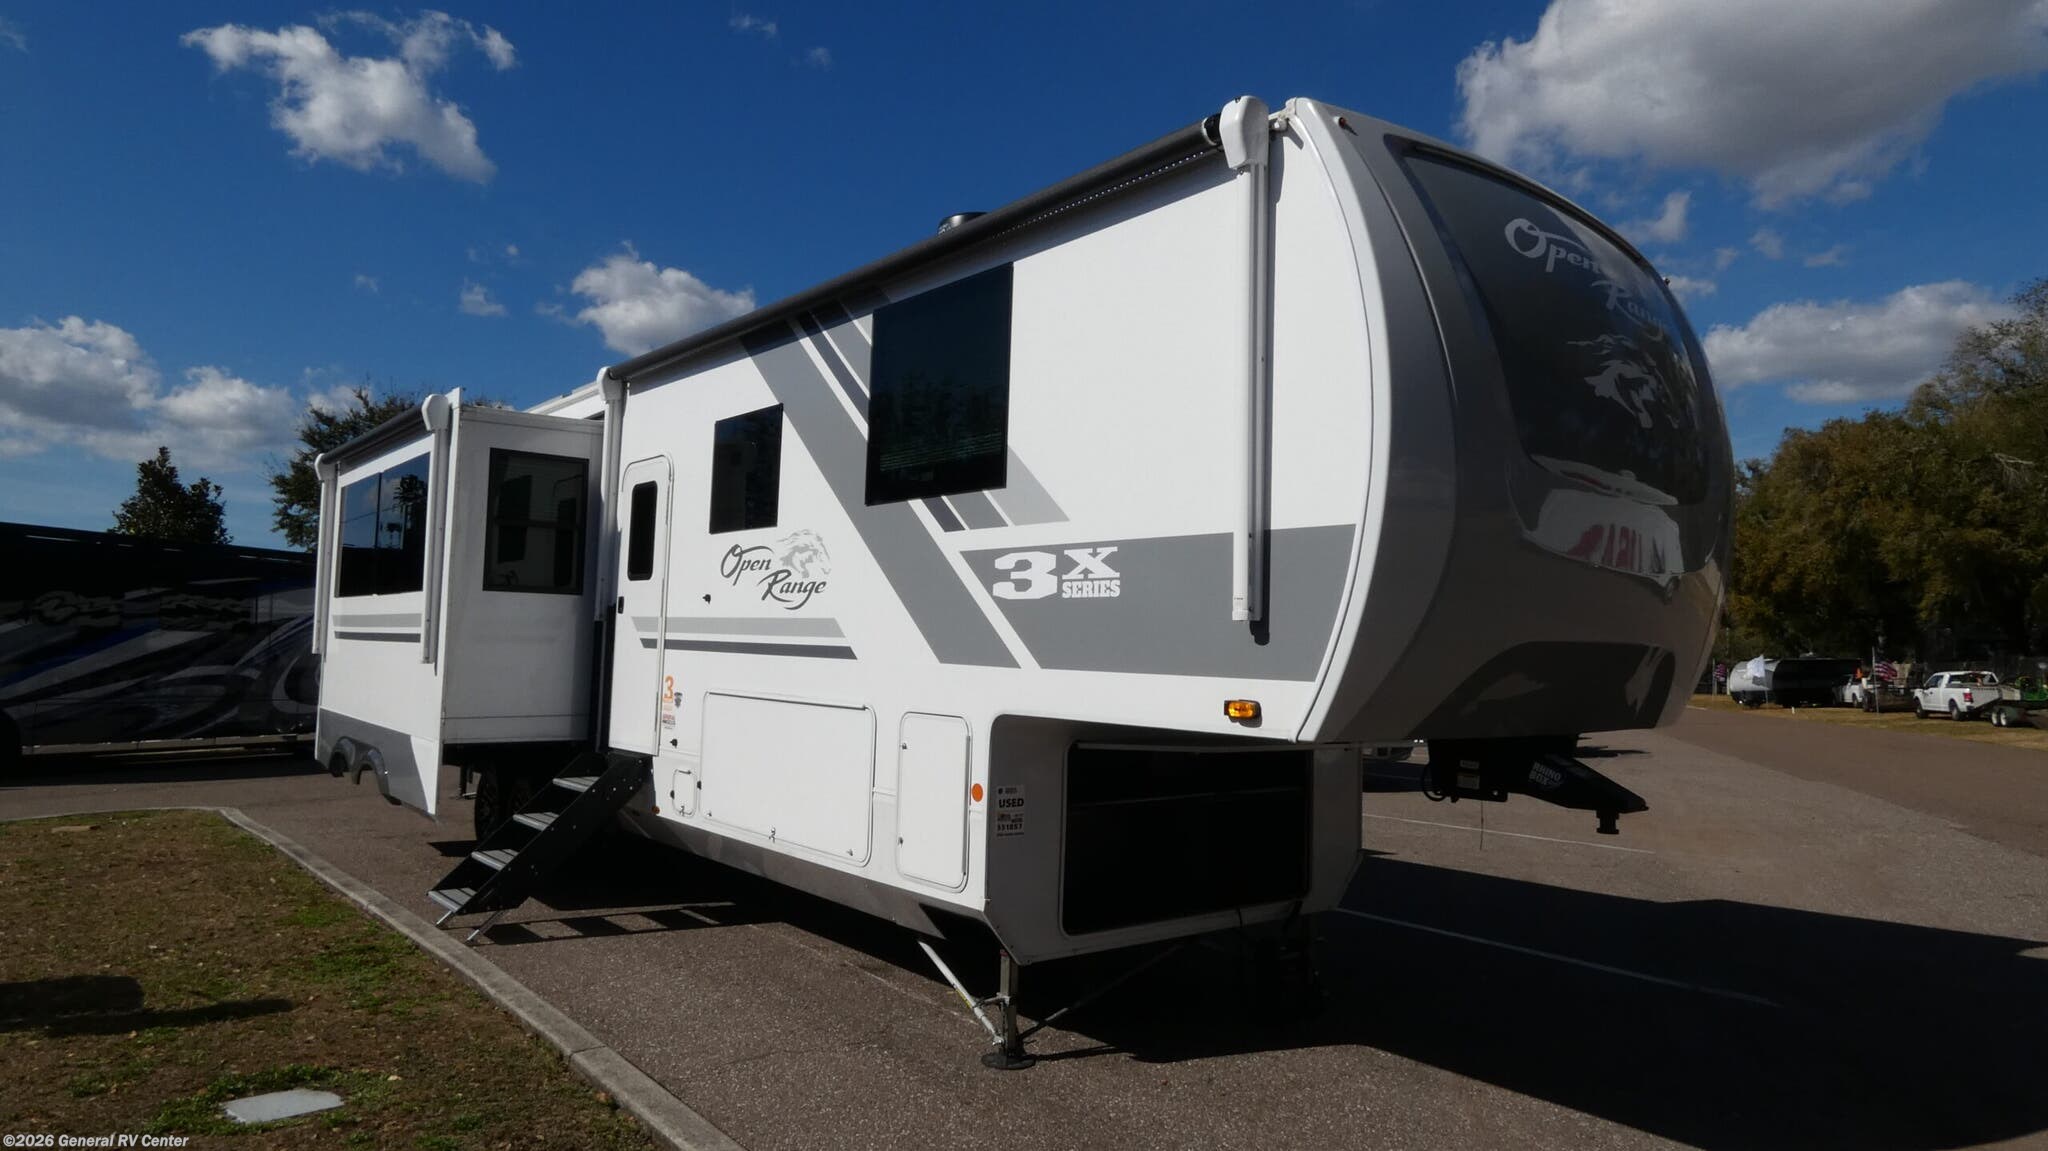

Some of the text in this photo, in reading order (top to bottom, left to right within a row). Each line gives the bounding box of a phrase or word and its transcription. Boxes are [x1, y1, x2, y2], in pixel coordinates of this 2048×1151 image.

[1504, 218, 1604, 274] Open
[1592, 280, 1664, 341] Ran
[721, 544, 774, 586] Open
[993, 546, 1120, 600] 3 X
[757, 569, 826, 610] Range
[1062, 580, 1120, 599] SERIES
[1528, 769, 1549, 786] BOX
[1532, 761, 1561, 782] RHINO
[998, 798, 1025, 808] USED
